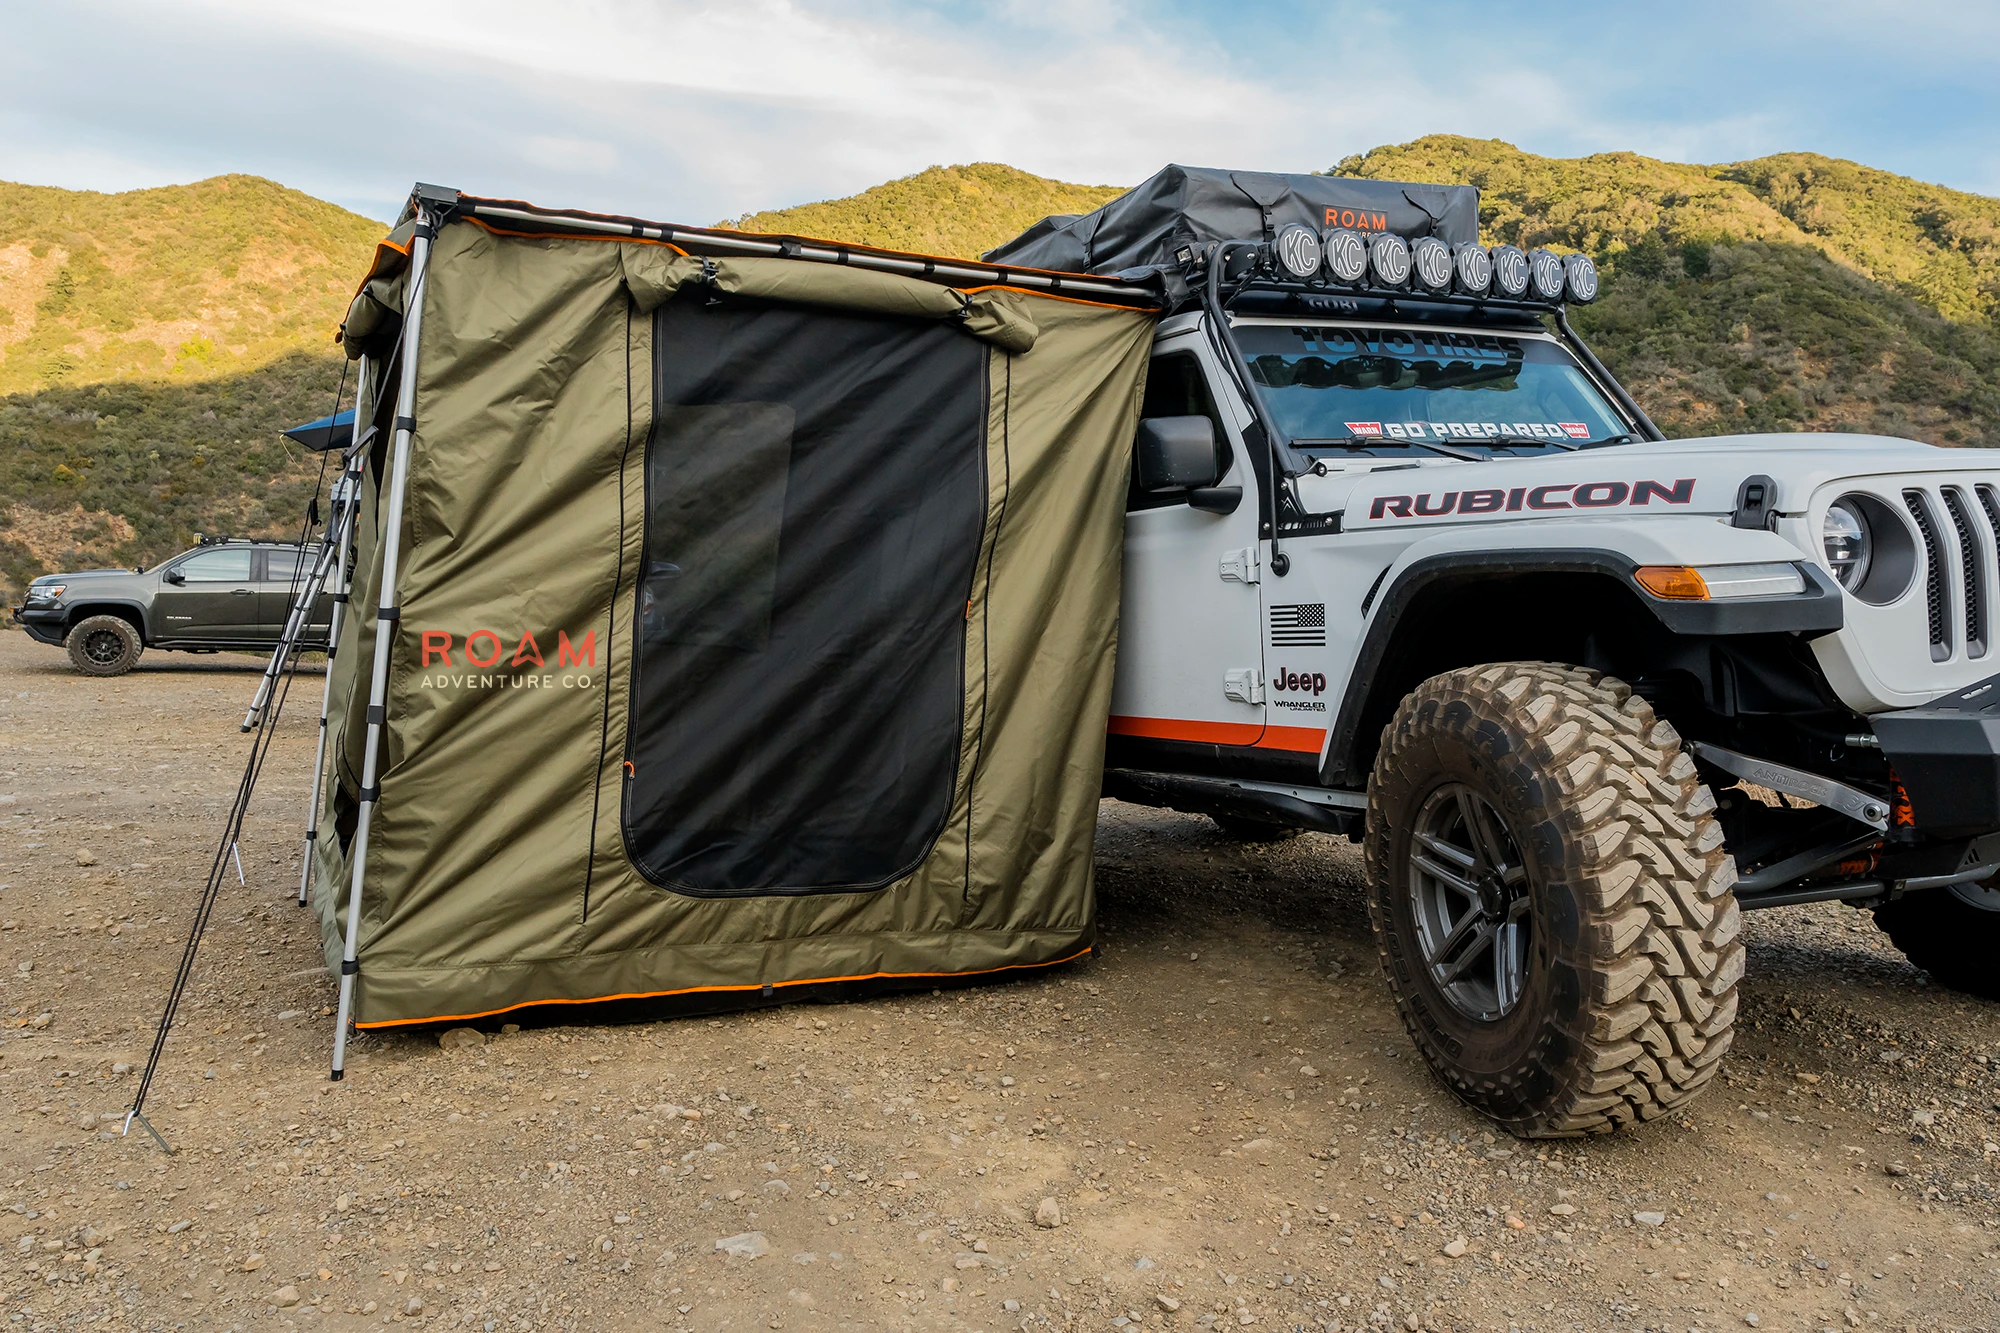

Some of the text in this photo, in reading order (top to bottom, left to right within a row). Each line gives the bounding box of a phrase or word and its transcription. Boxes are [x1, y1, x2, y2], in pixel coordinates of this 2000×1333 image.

[1325, 208, 1386, 231] ROAM
[1284, 229, 1316, 274] KC
[1332, 234, 1362, 277] KC
[1377, 239, 1407, 281] KC
[1421, 243, 1449, 285] KC
[1462, 247, 1488, 288] KC
[1500, 251, 1525, 291] KC
[1537, 255, 1561, 295] KC
[1571, 259, 1595, 298] KC
[1384, 423, 1426, 438] GO
[1429, 423, 1563, 438] PREPARED
[1369, 478, 1697, 519] RUBICON
[422, 630, 596, 668] ROAM
[421, 675, 596, 689] ADVENTURE CO.
[1273, 667, 1327, 697] Jeep
[1274, 700, 1326, 709] WRANGLER
[1753, 767, 1828, 799] ANTIROCK
